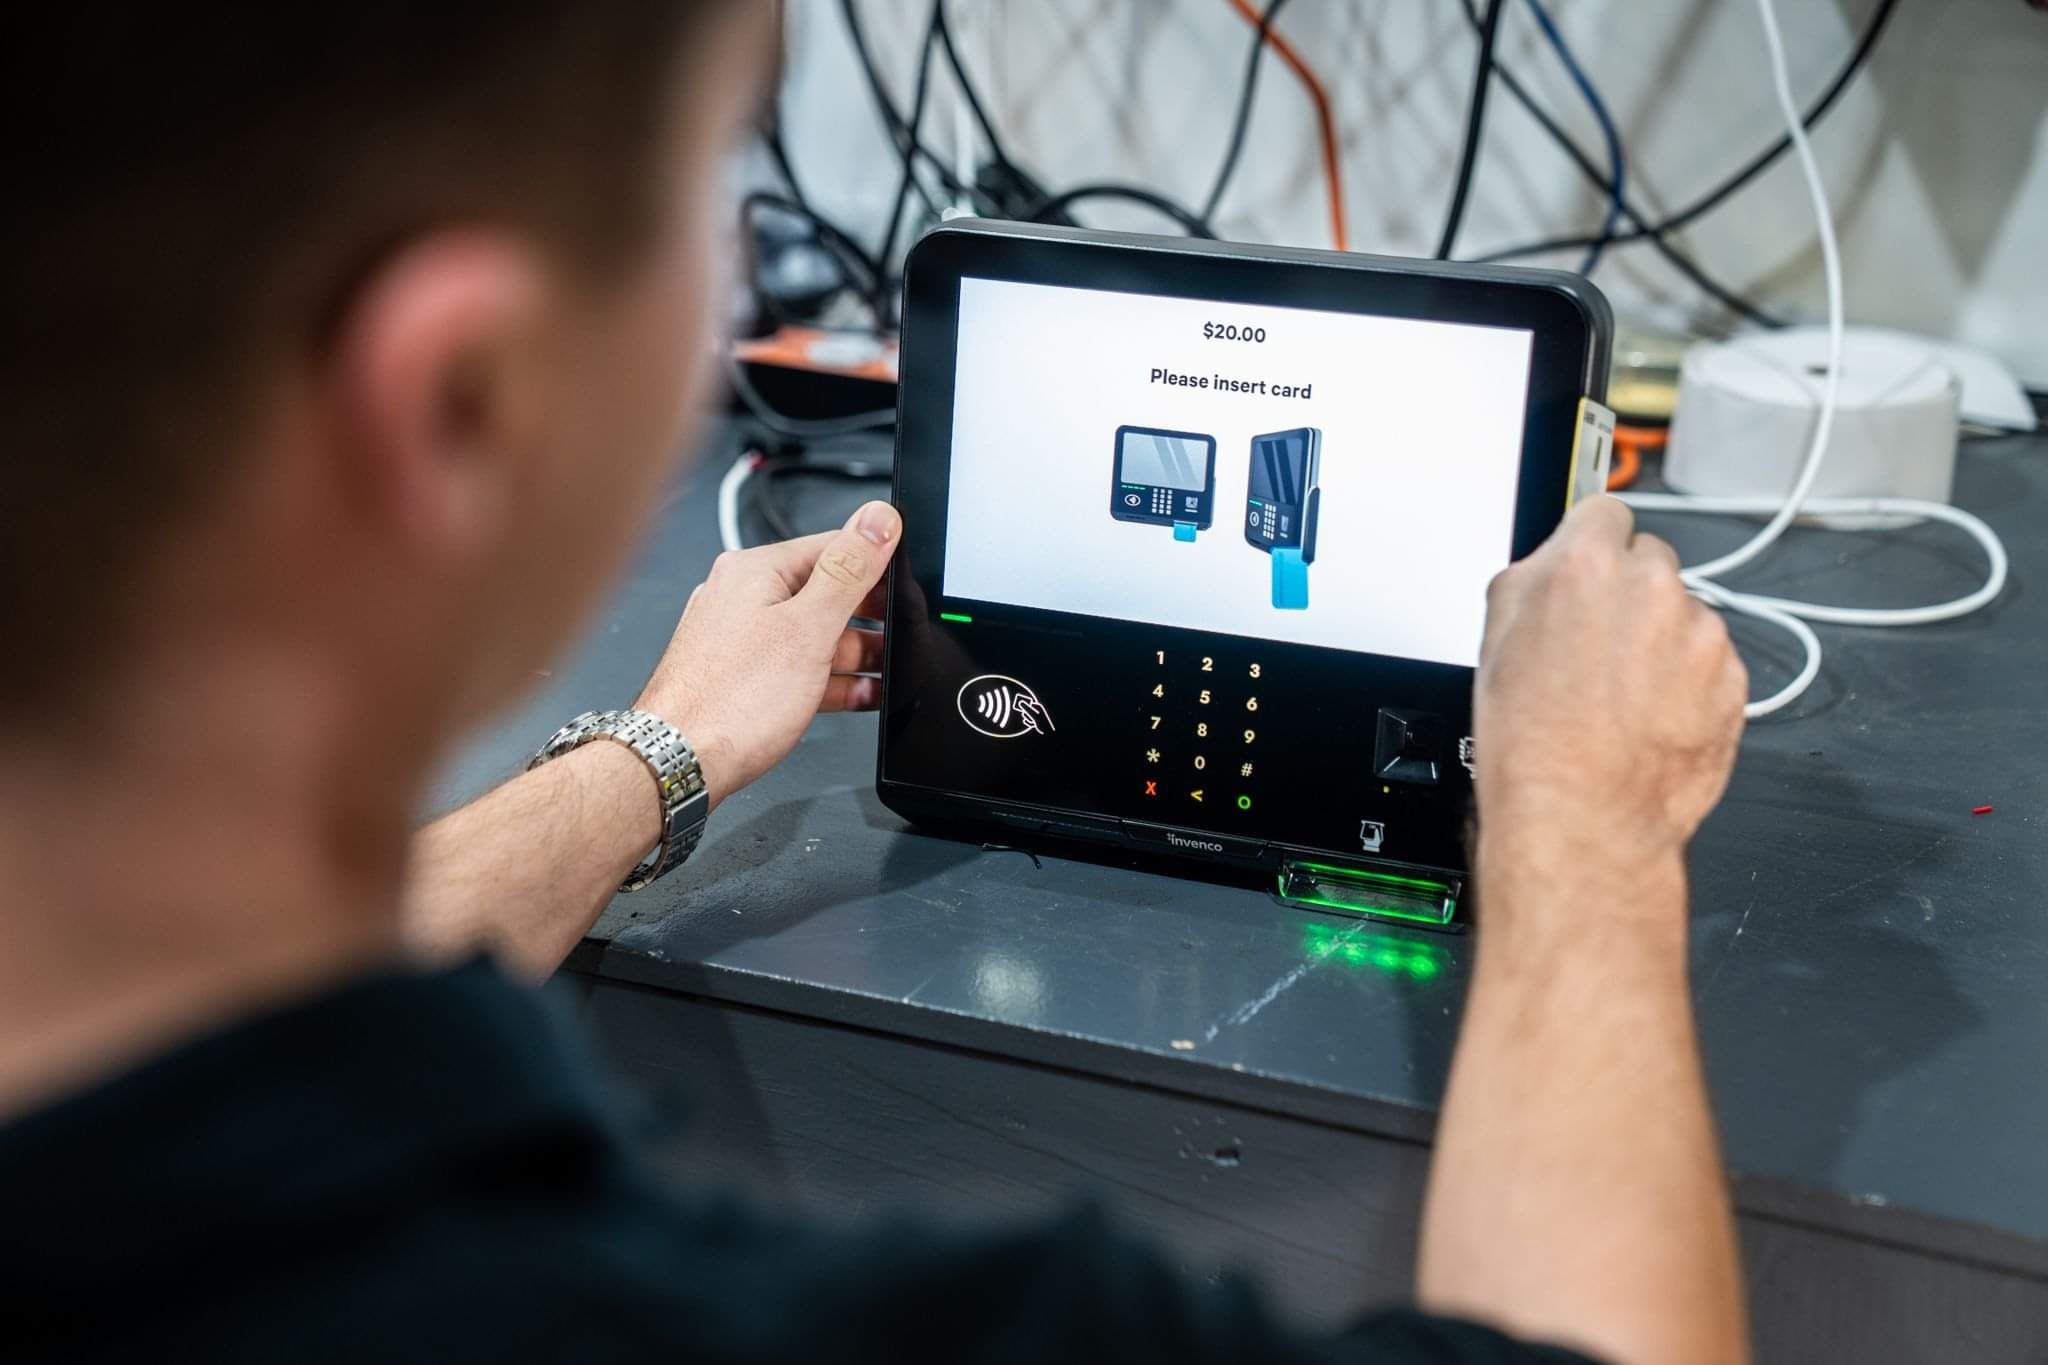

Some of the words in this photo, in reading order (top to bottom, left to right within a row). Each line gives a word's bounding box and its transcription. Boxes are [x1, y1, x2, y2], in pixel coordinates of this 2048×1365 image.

[1203, 321, 1266, 343] $20.00
[1150, 368, 1209, 388] Please
[1213, 374, 1266, 395] insert
[1271, 384, 1312, 399] card
[1156, 651, 1165, 665] 1
[1201, 657, 1213, 672] 2
[1249, 663, 1261, 678] 3
[1152, 684, 1164, 698] 4
[1200, 690, 1211, 704] 5
[1246, 697, 1258, 711] 6
[1151, 716, 1161, 729] 7
[1197, 723, 1208, 737] 8
[1244, 729, 1255, 744] 9
[1194, 756, 1206, 770] 0
[1241, 762, 1253, 777] #
[1168, 833, 1223, 852] invenco
